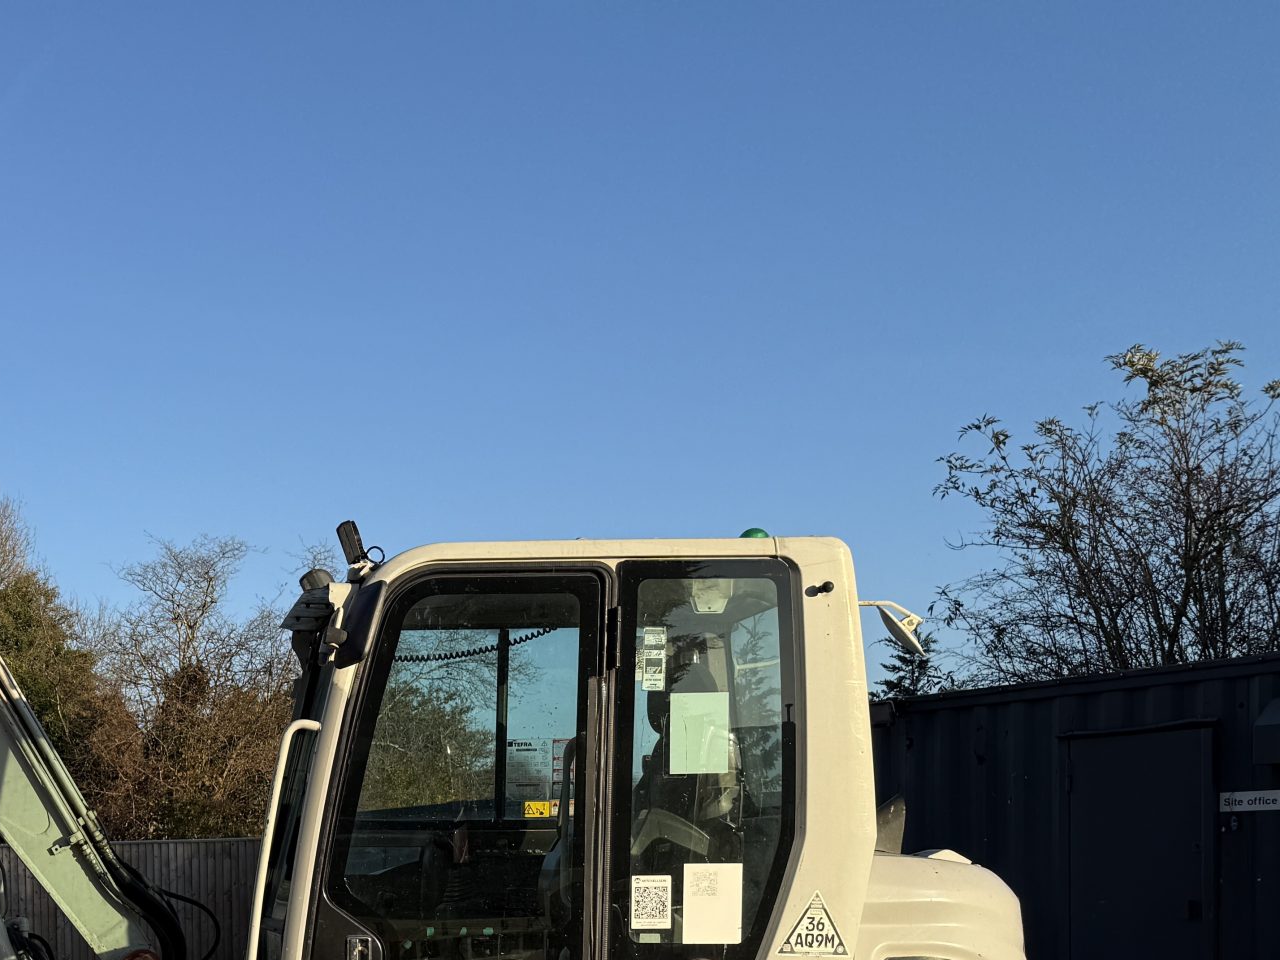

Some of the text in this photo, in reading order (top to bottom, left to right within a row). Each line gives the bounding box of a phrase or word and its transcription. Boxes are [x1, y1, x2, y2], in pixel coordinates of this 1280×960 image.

[1223, 796, 1277, 806] Site office
[806, 916, 825, 931] 36
[794, 933, 835, 948] AQ9M
